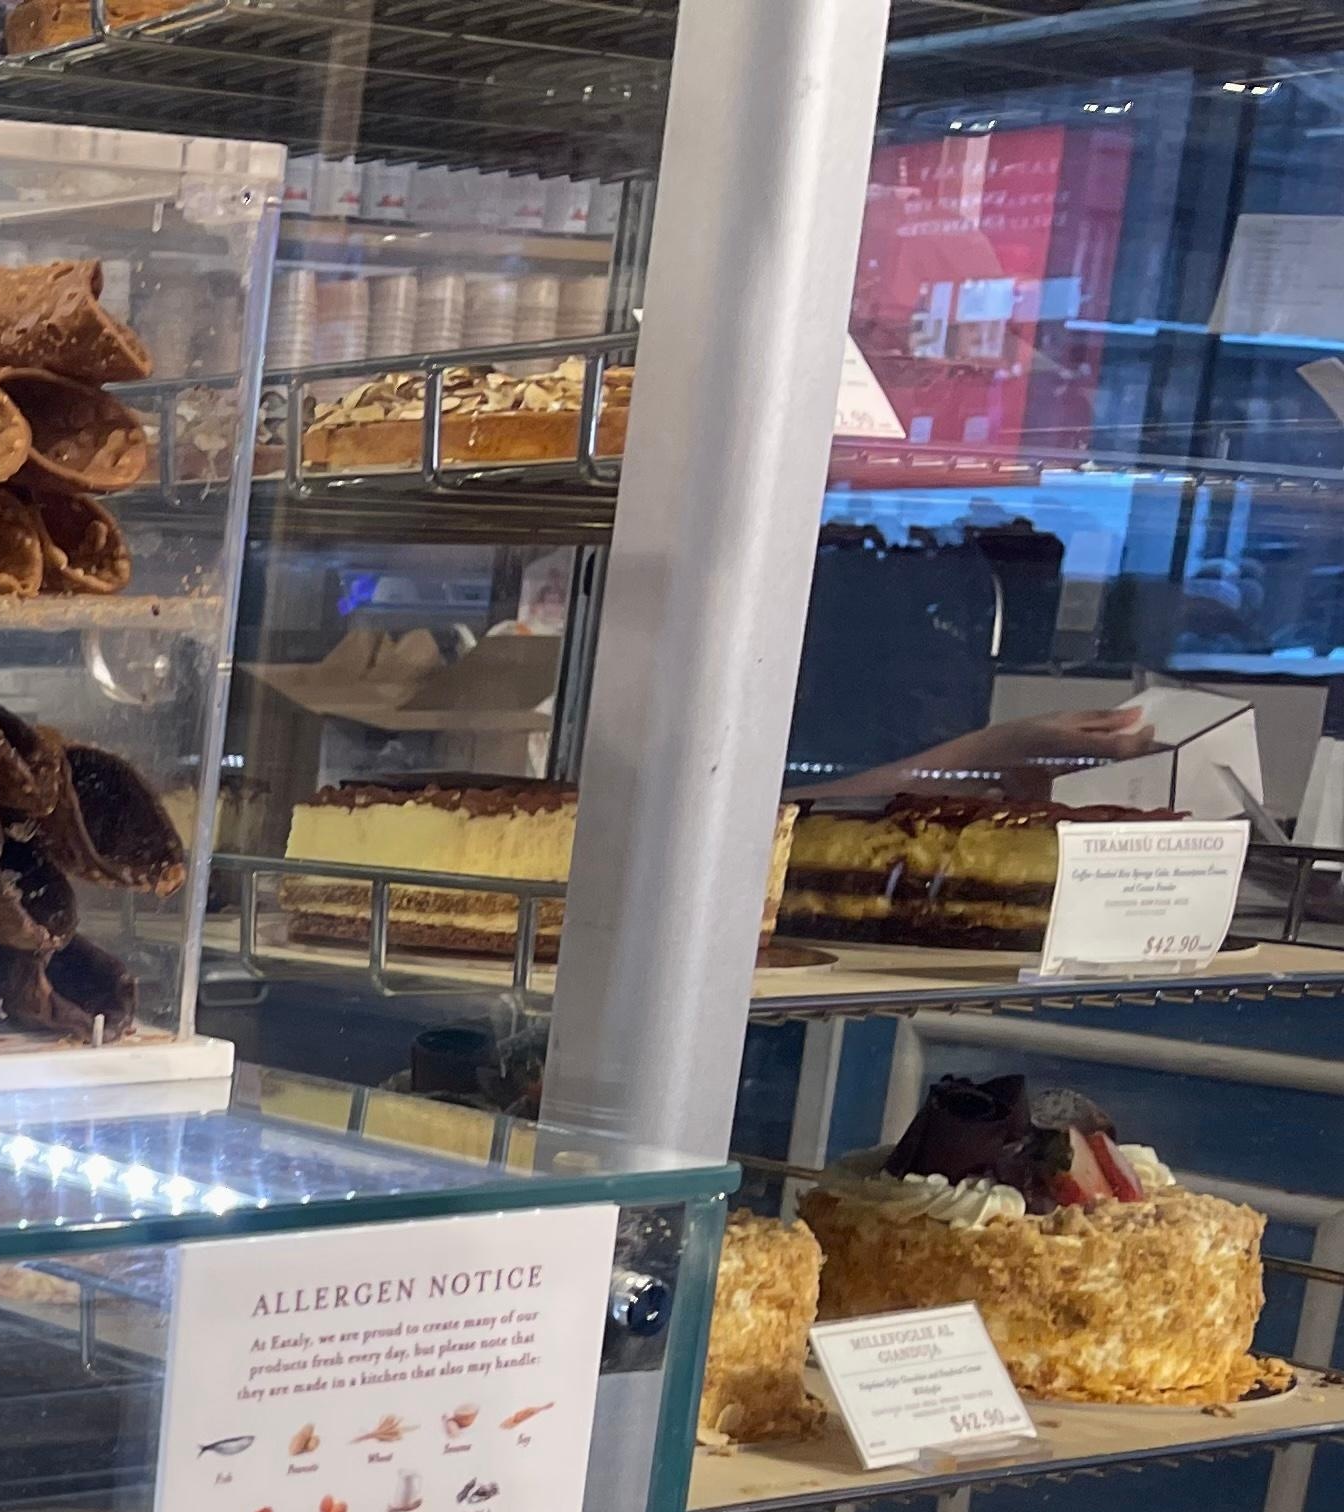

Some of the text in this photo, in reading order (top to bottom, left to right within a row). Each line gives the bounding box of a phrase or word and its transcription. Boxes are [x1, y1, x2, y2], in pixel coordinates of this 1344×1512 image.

[1156, 836, 1225, 851] CLASSICO
[250, 1264, 545, 1317] ALLERGEN NOTICE
[250, 1310, 539, 1353] At Eataly, we are proud to create many of our
[249, 1331, 535, 1379] products fresh every day, but please note that
[236, 1383, 265, 1403] they
[268, 1383, 289, 1396] are
[293, 1376, 329, 1393] made
[332, 1375, 346, 1388] in
[349, 1376, 356, 1386] a
[360, 1367, 407, 1385] kitchen
[410, 1364, 436, 1379] that
[439, 1361, 464, 1376] also
[466, 1360, 492, 1377] may
